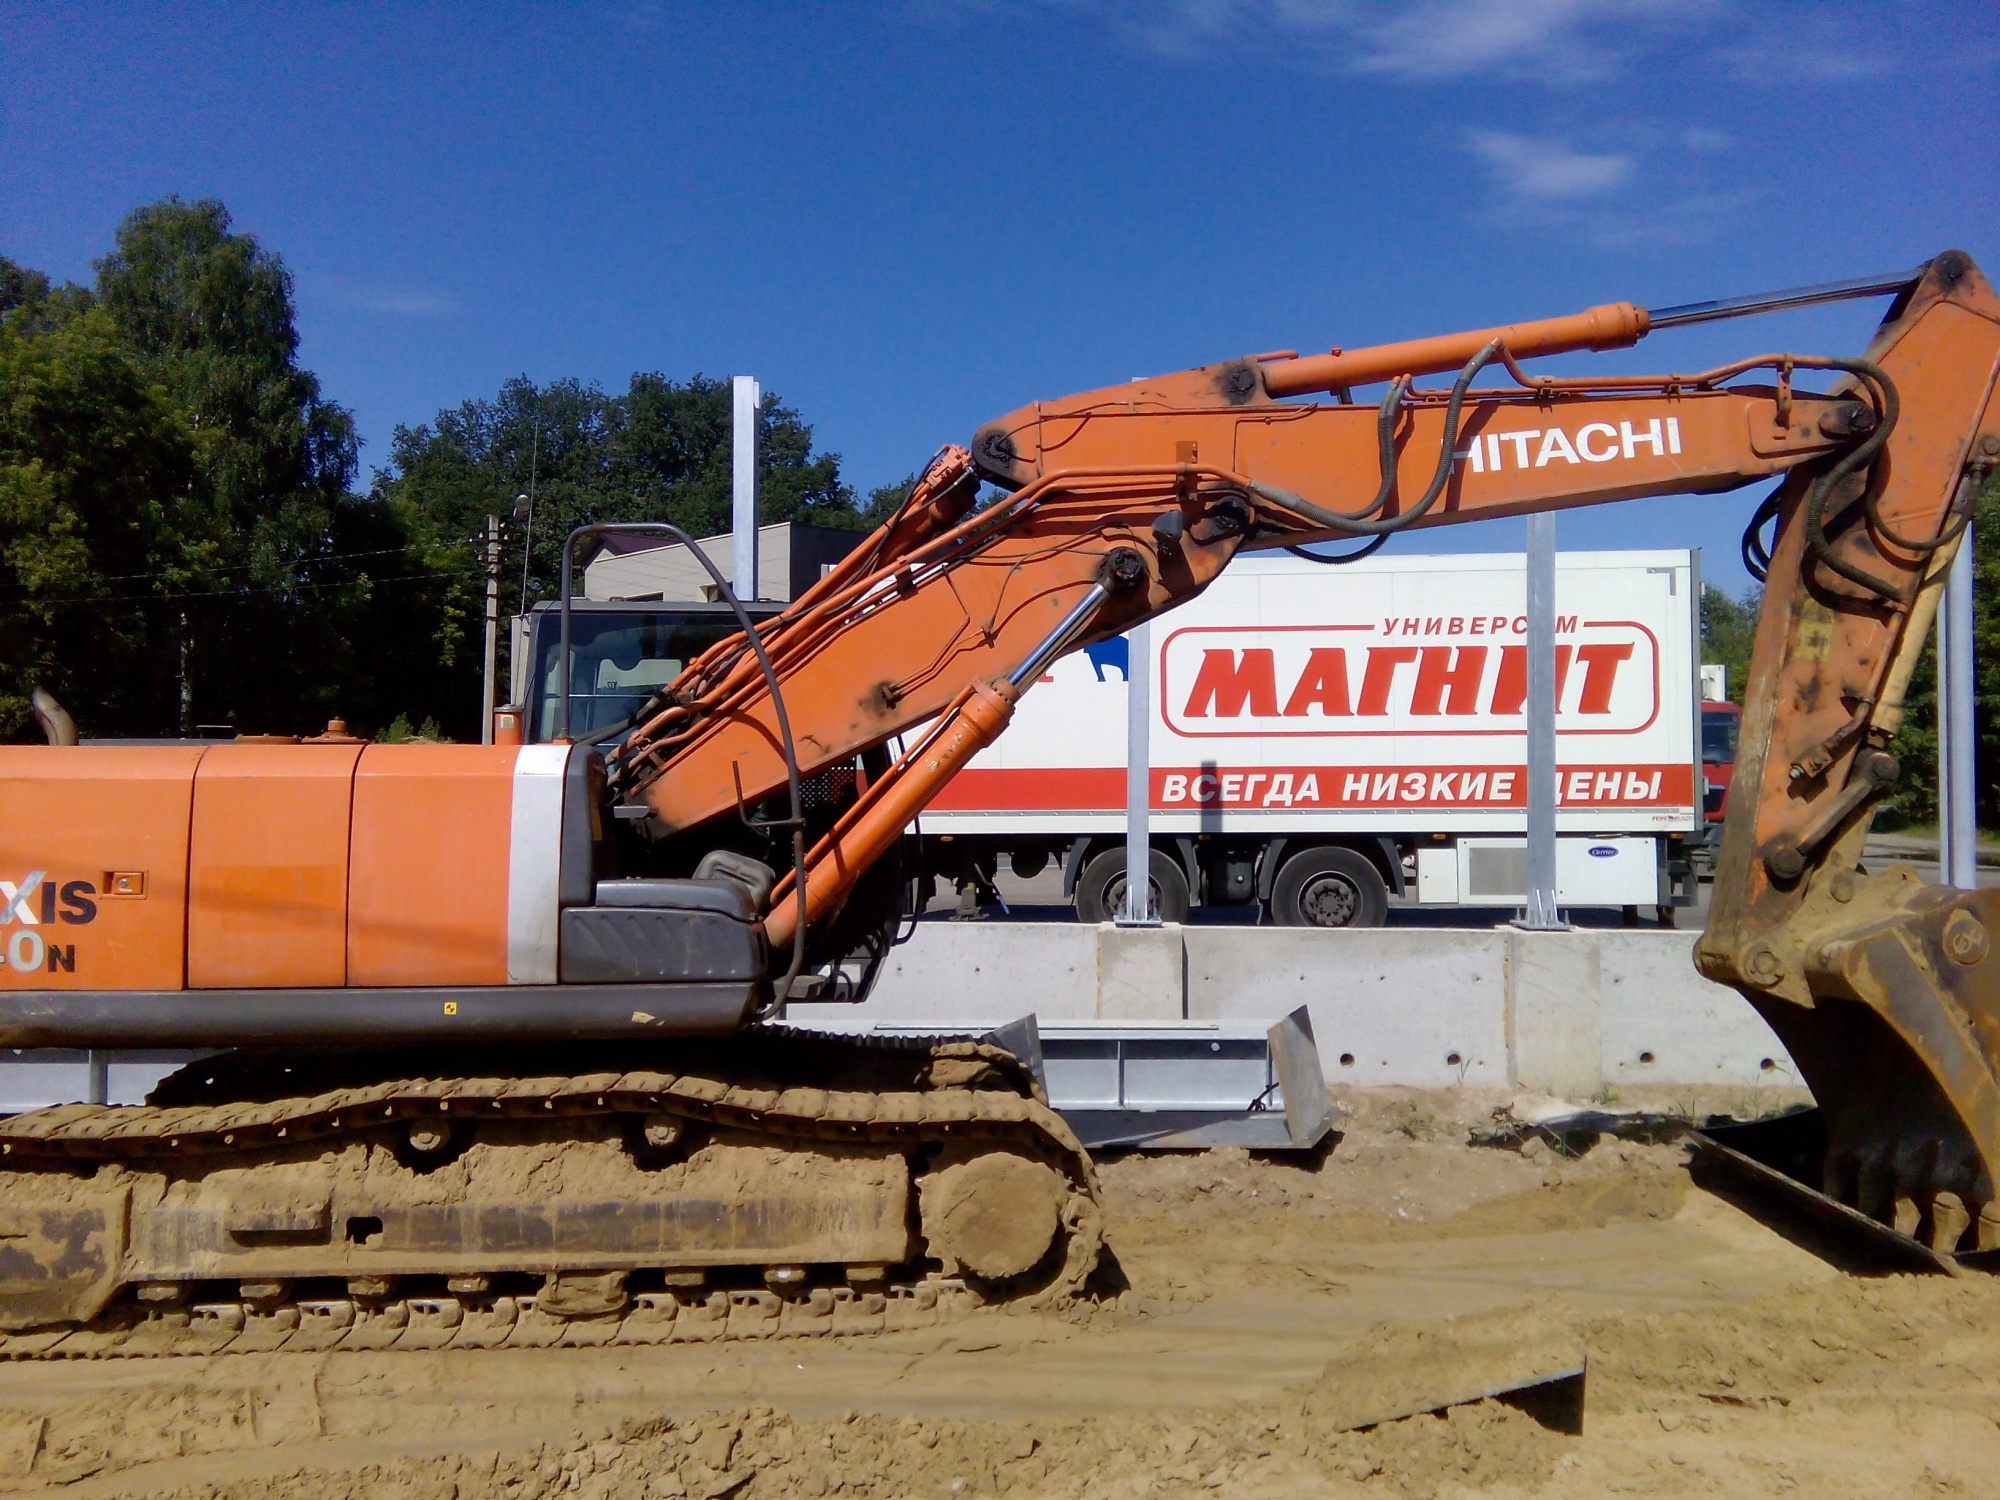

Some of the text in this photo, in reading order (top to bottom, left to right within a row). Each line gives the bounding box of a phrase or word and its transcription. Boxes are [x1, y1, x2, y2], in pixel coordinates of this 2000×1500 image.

[1441, 416, 1682, 475] HITACHI
[1383, 615, 1579, 637] УНИВЕРСМ
[1183, 641, 1636, 718] МАГНИТ
[1161, 771, 1663, 807] ВСЕГДА НИЗКИЕ ЕНЫ
